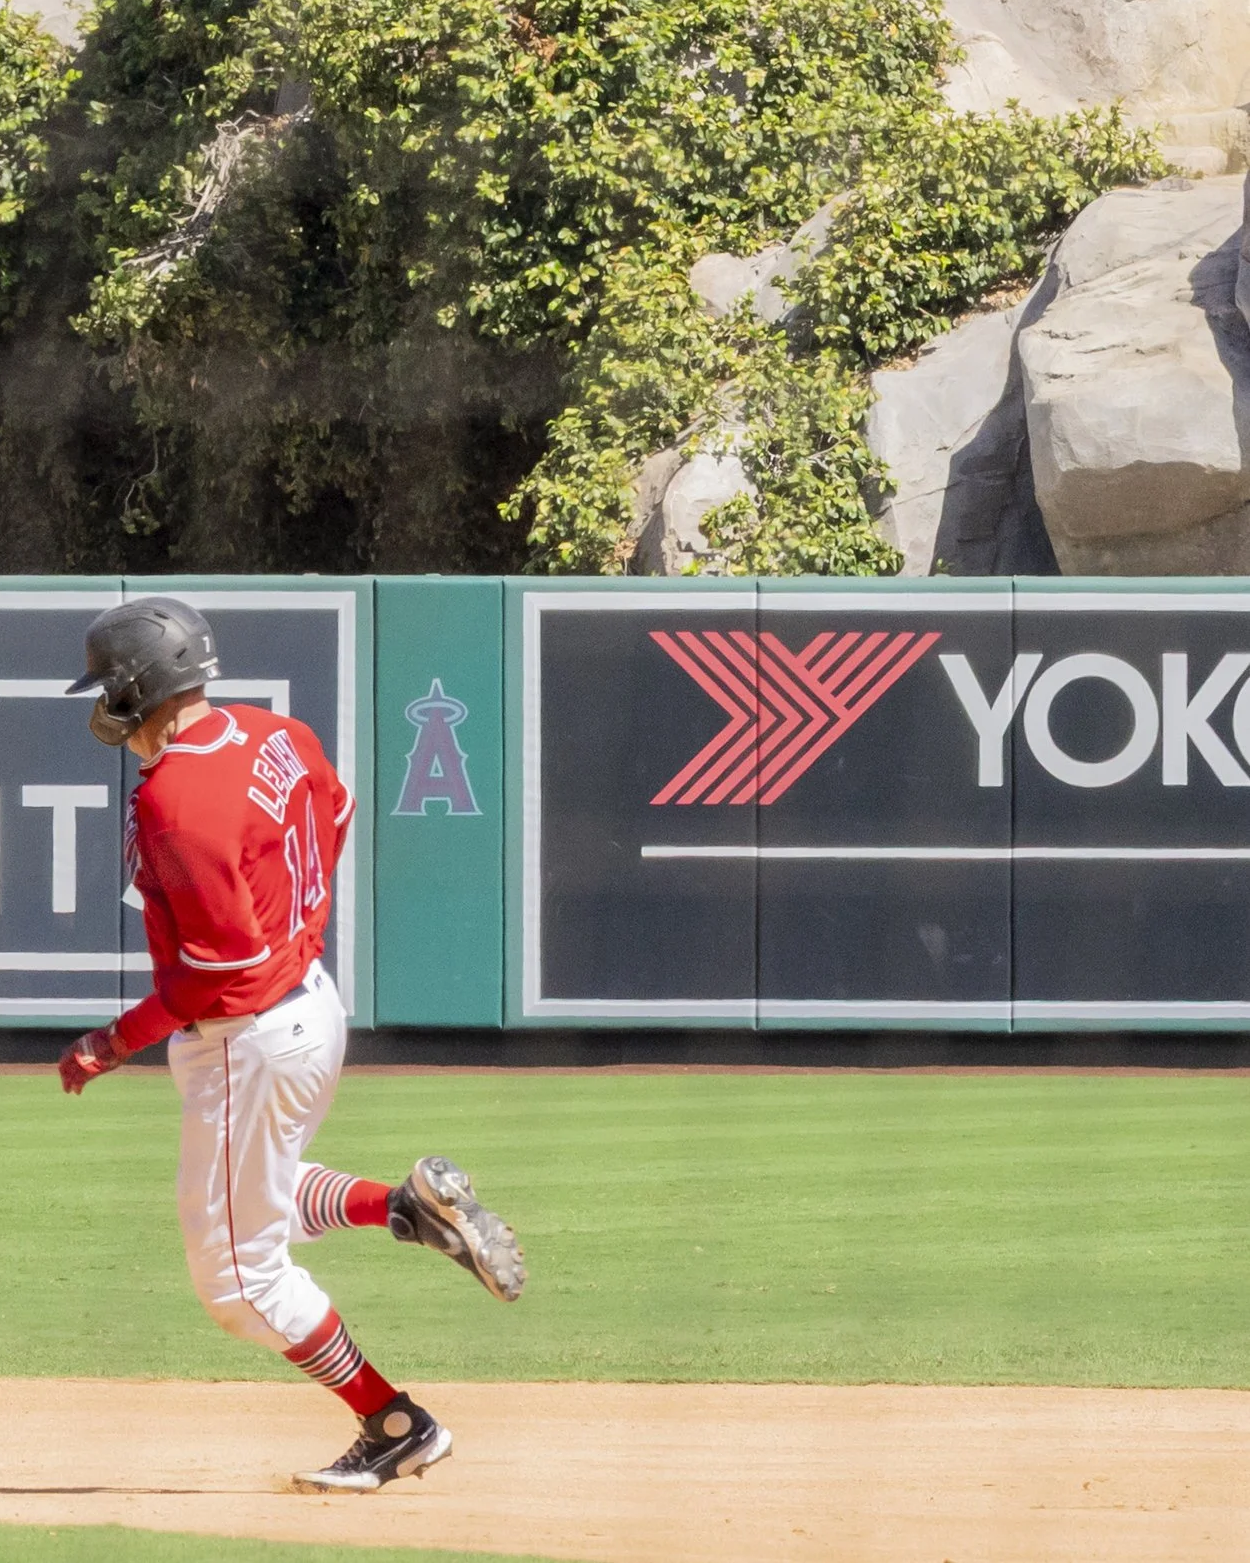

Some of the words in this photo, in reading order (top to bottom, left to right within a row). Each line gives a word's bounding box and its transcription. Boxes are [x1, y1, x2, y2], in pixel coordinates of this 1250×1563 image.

[390, 678, 484, 816] A
[938, 652, 1250, 788] YOK
[284, 790, 326, 942] 14
